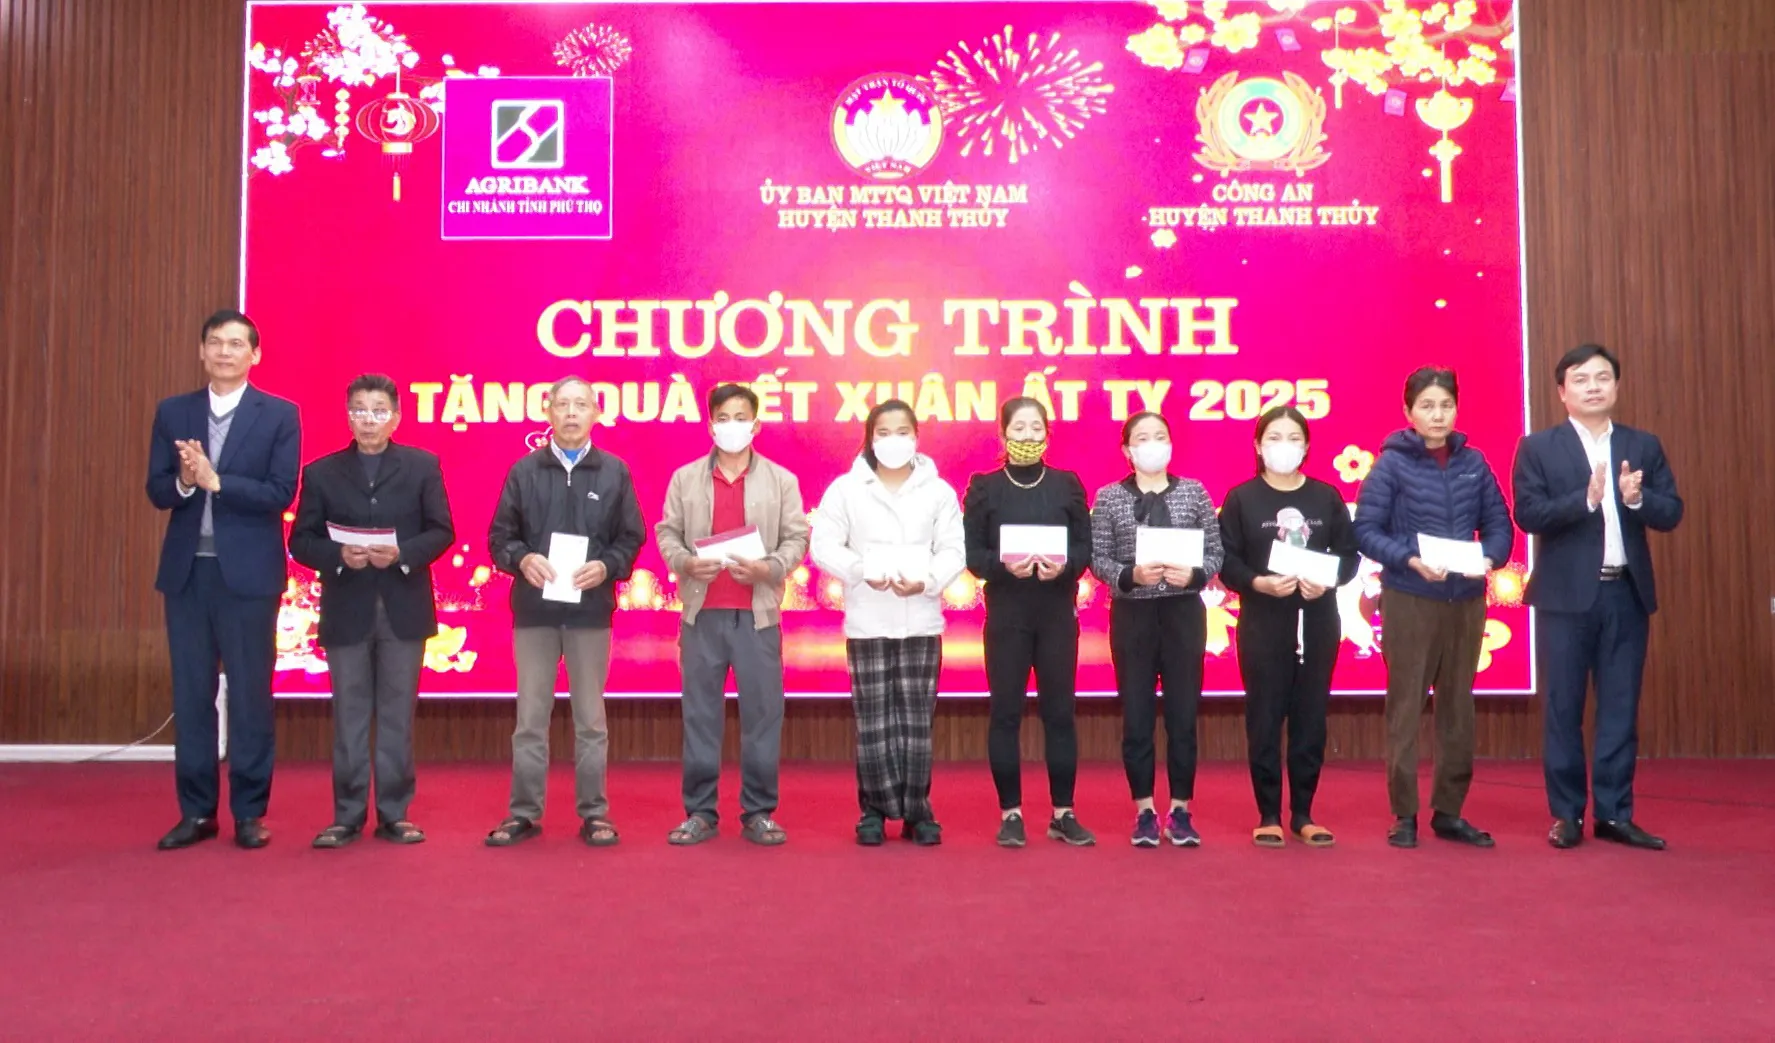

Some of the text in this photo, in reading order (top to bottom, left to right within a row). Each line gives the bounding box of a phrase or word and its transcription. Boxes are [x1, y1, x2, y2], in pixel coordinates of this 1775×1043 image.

[464, 175, 591, 195] AGRIBANK
[760, 178, 1028, 208] ỦY BAN MTTQ VIỆT NAM
[1212, 179, 1315, 202] CÔNG AN
[448, 200, 470, 214] CHI
[472, 197, 516, 214] NHÁNH
[517, 196, 547, 214] TỈNH
[577, 200, 603, 215] THỌ
[778, 203, 1009, 232] HUYỆN THANH THỦY
[1149, 199, 1380, 232] HUYỆN THANH THỦY
[536, 280, 1240, 358] CHƯƠNG TRÌNH
[717, 367, 818, 423] ẾT
[1189, 379, 1332, 421] 2025
